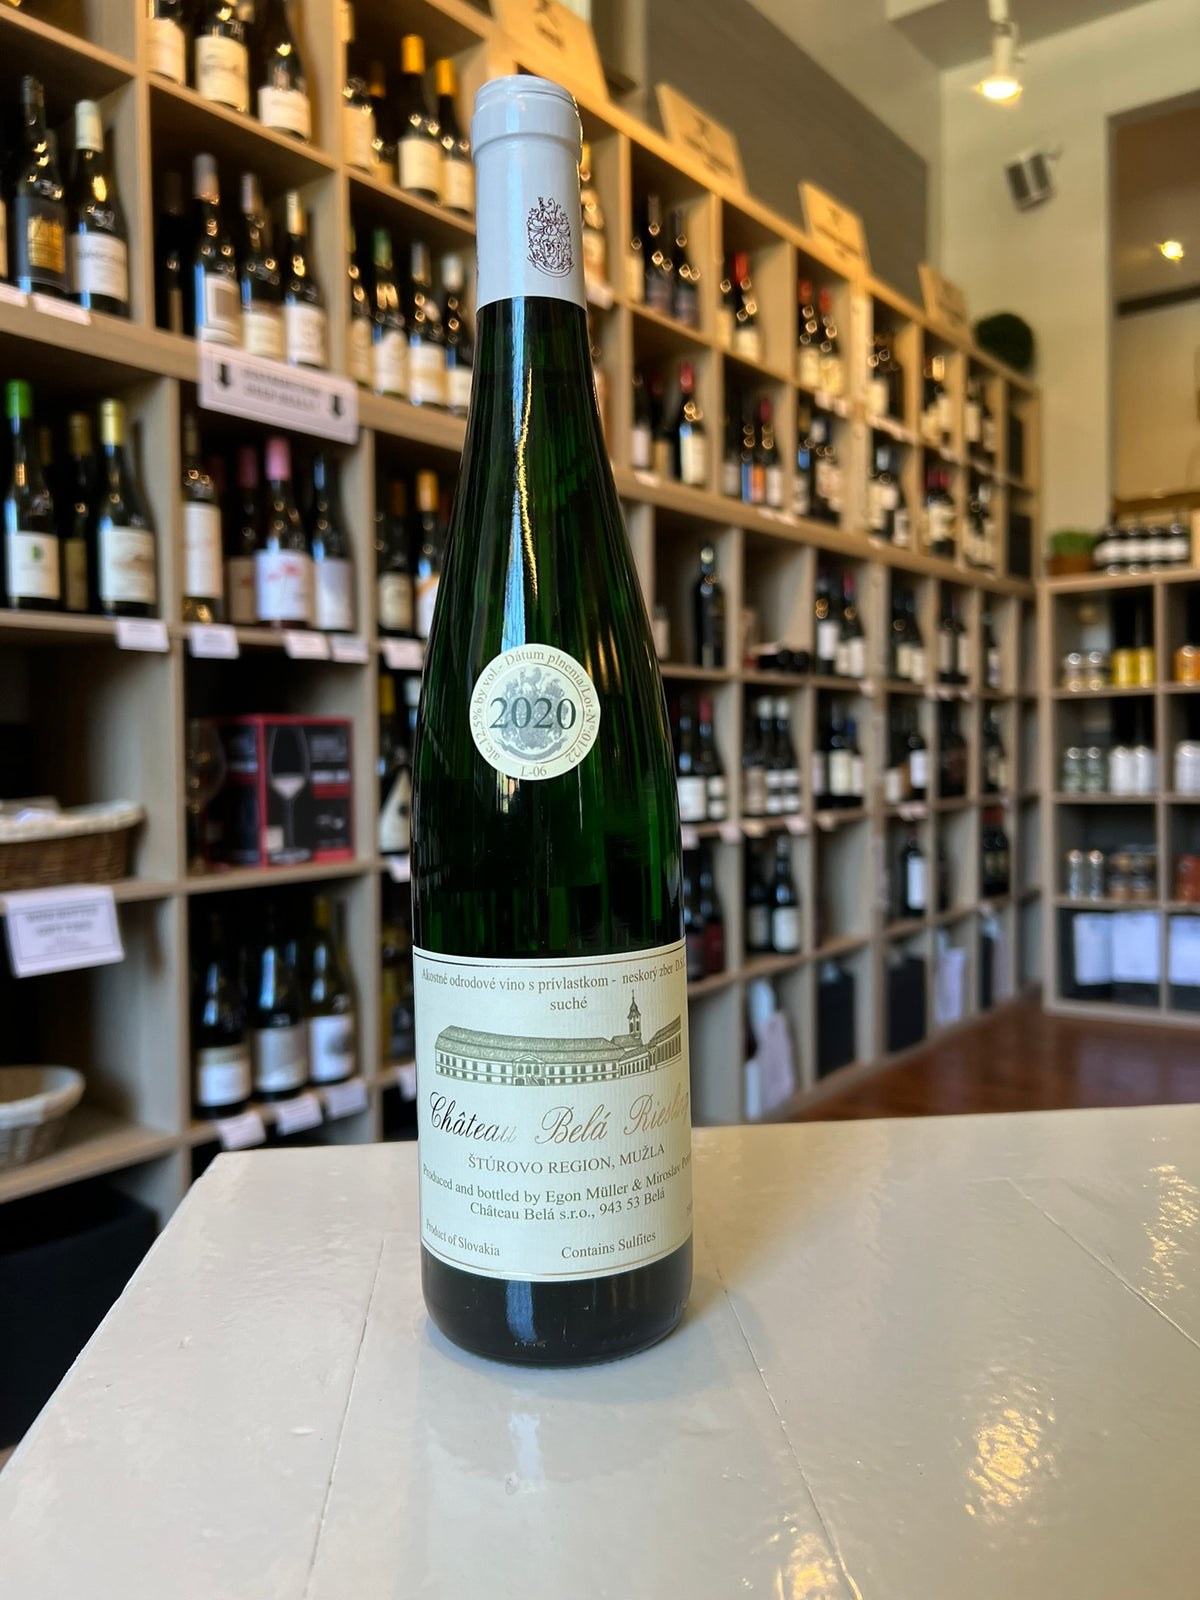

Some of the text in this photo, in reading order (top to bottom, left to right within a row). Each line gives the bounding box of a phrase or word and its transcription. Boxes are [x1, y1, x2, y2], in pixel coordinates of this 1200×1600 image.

[473, 690, 487, 705] by
[504, 651, 544, 666] Dátum
[489, 697, 577, 729] 2020
[520, 766, 547, 777] L-06
[422, 967, 448, 985] Akostné
[449, 974, 496, 990] odrodové
[499, 977, 525, 991] víno
[528, 981, 535, 990] s
[538, 975, 609, 994] prívlastkom
[622, 966, 657, 983] neskorý
[659, 963, 673, 977] zber
[550, 996, 588, 1010] suché
[429, 1091, 518, 1143] Château
[534, 1103, 612, 1145] Belá
[468, 1153, 543, 1174] ŠTÚROVO
[548, 1156, 615, 1174] REGION,
[619, 1143, 665, 1166] MUŽLA
[423, 1162, 681, 1206] Produced and bottled by Egon Müller & Miroslav
[470, 1187, 665, 1220] Château Belá s.r.o., 943 53 Belá
[426, 1218, 657, 1259] Product of Slovakia Contains Sulfites
